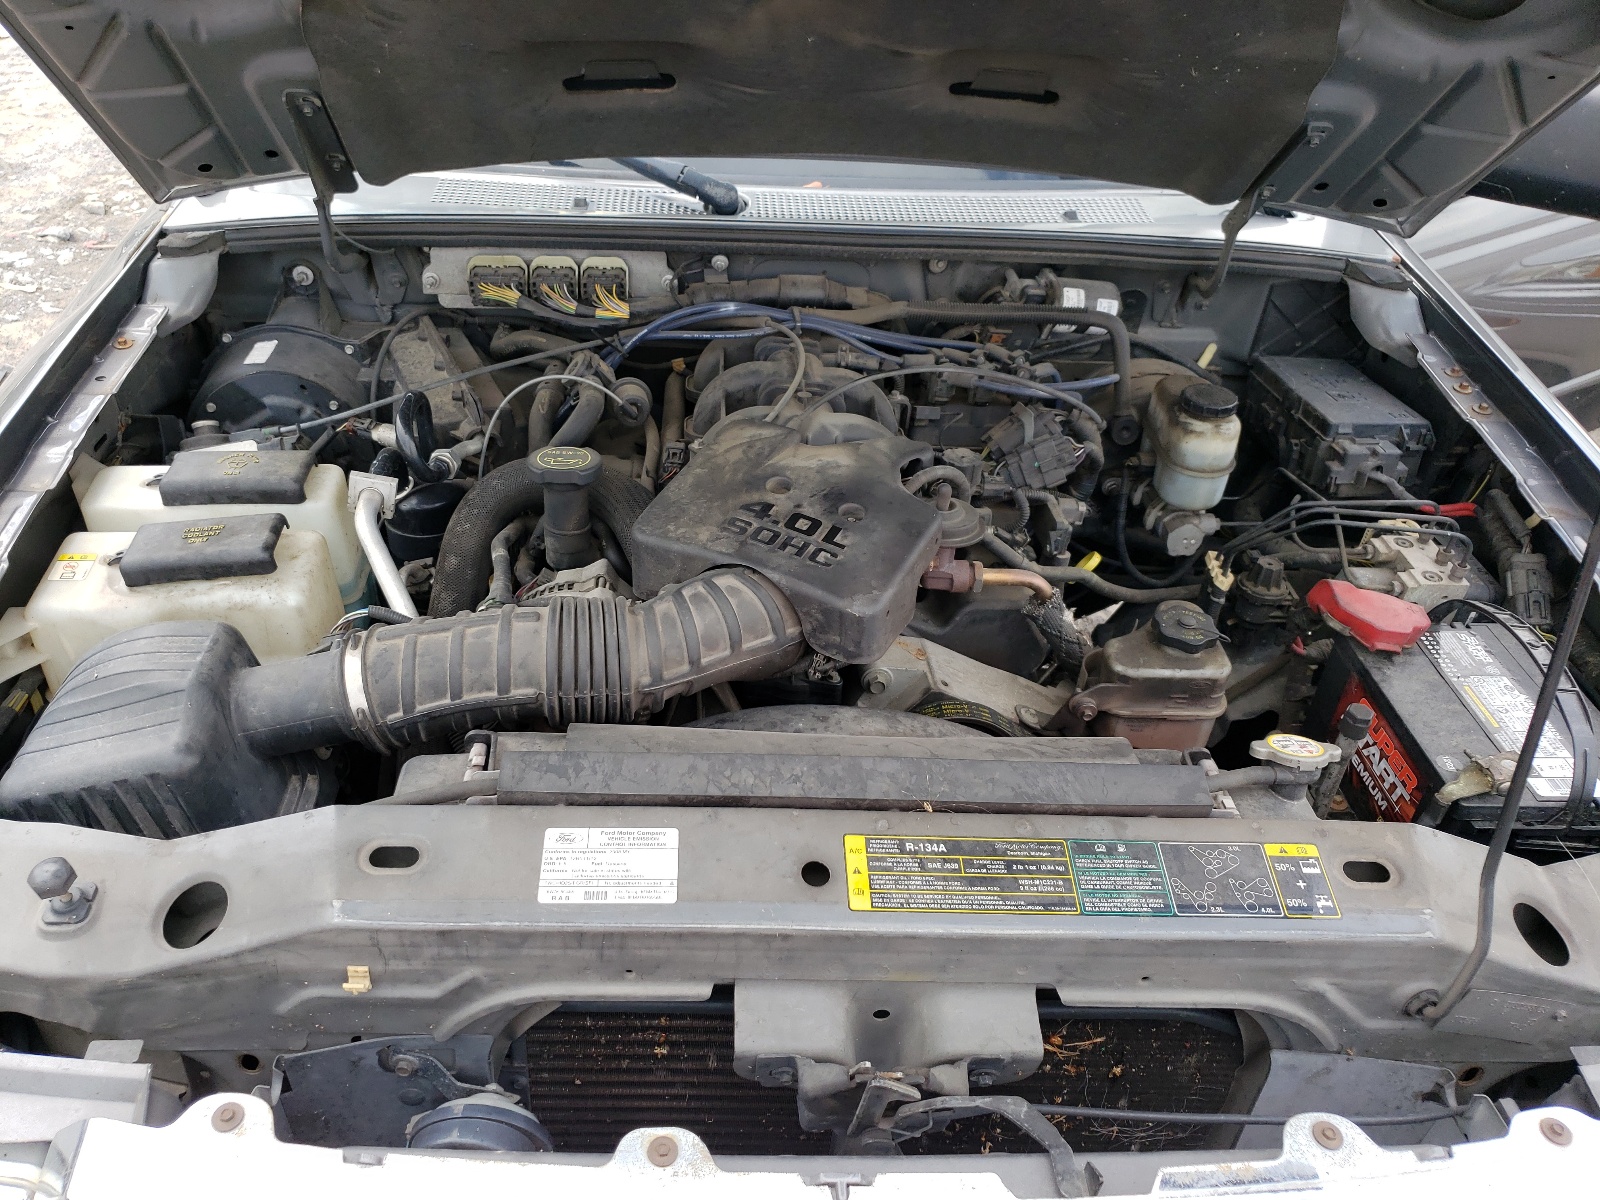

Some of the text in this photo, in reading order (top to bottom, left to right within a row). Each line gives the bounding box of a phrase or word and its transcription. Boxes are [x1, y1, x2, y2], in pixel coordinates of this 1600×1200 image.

[184, 524, 225, 533] RADIATOR
[739, 501, 846, 550] 4.0L
[182, 530, 221, 539] COOLANT
[721, 516, 839, 568] SOHC
[1360, 698, 1418, 794] UPER
[1352, 754, 1388, 810] EMIUM
[556, 834, 576, 843] Ford
[905, 842, 947, 852] R-134A
[1275, 863, 1295, 871] 50%
[1286, 899, 1307, 907] 50%
